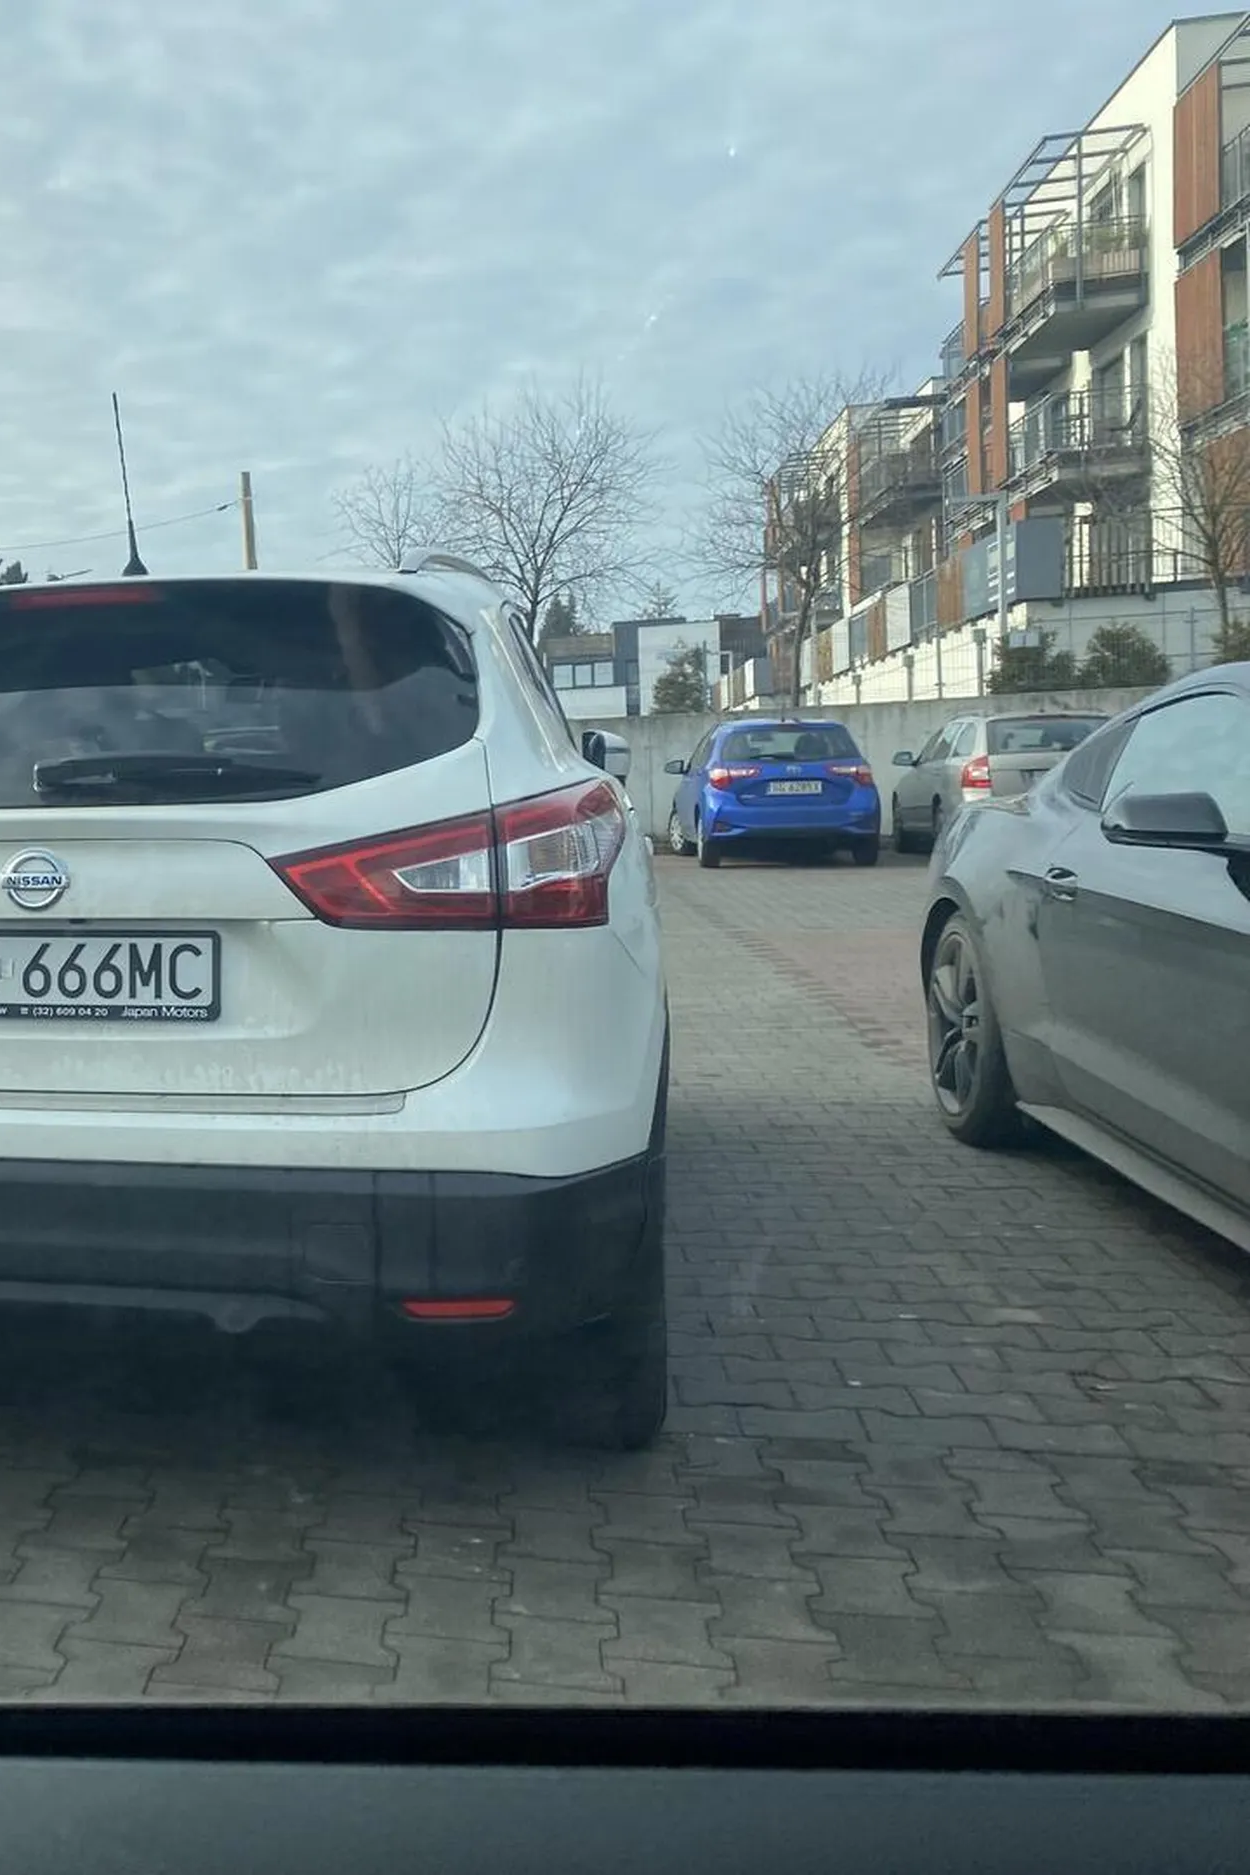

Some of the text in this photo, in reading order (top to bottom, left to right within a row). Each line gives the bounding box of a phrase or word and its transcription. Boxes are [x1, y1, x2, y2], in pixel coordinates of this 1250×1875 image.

[7, 875, 62, 886] NISSAN
[22, 943, 203, 999] 666MC
[121, 1006, 159, 1018] Japan
[161, 1006, 209, 1018] Motors
